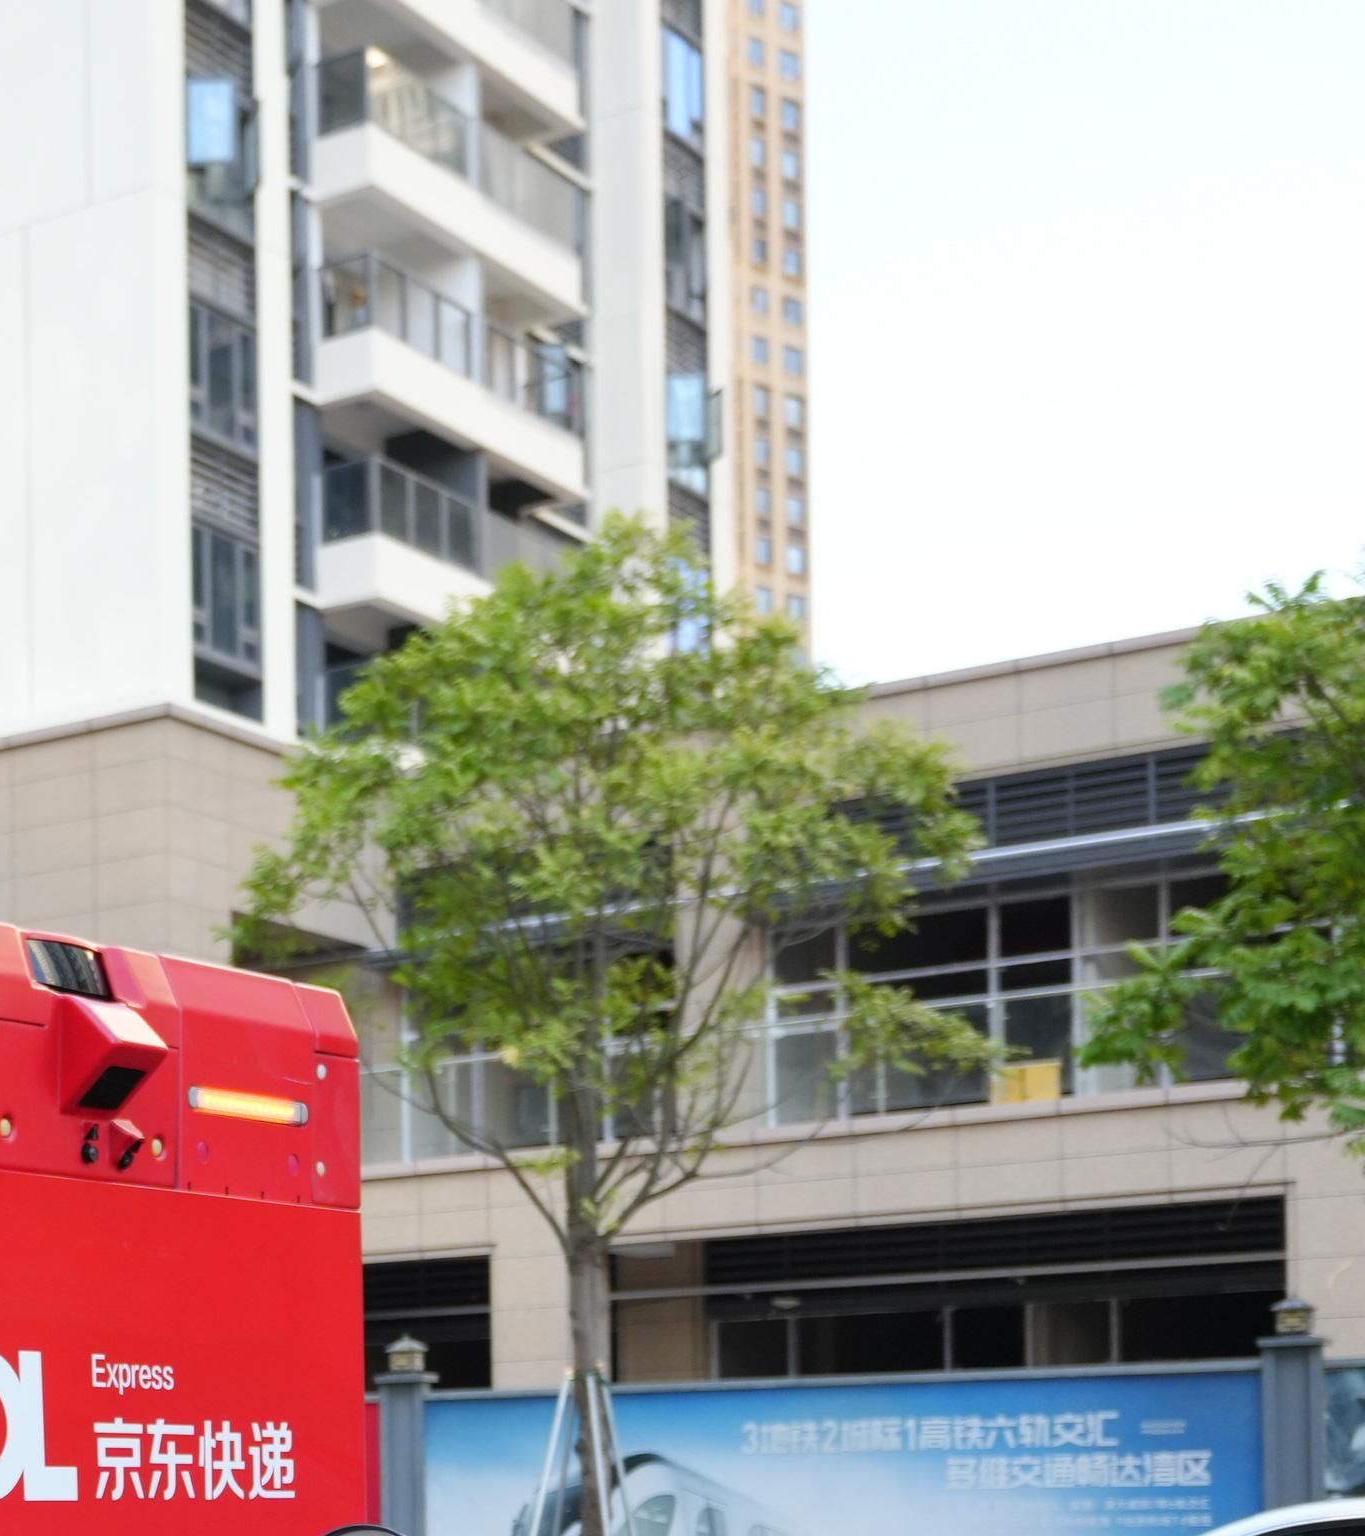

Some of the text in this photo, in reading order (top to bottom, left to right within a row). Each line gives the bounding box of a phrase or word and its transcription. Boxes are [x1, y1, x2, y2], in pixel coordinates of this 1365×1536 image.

[91, 1353, 175, 1394] Express
[93, 1417, 296, 1501] 京东快递
[946, 1450, 1213, 1490] 多维交通畅达湾区
